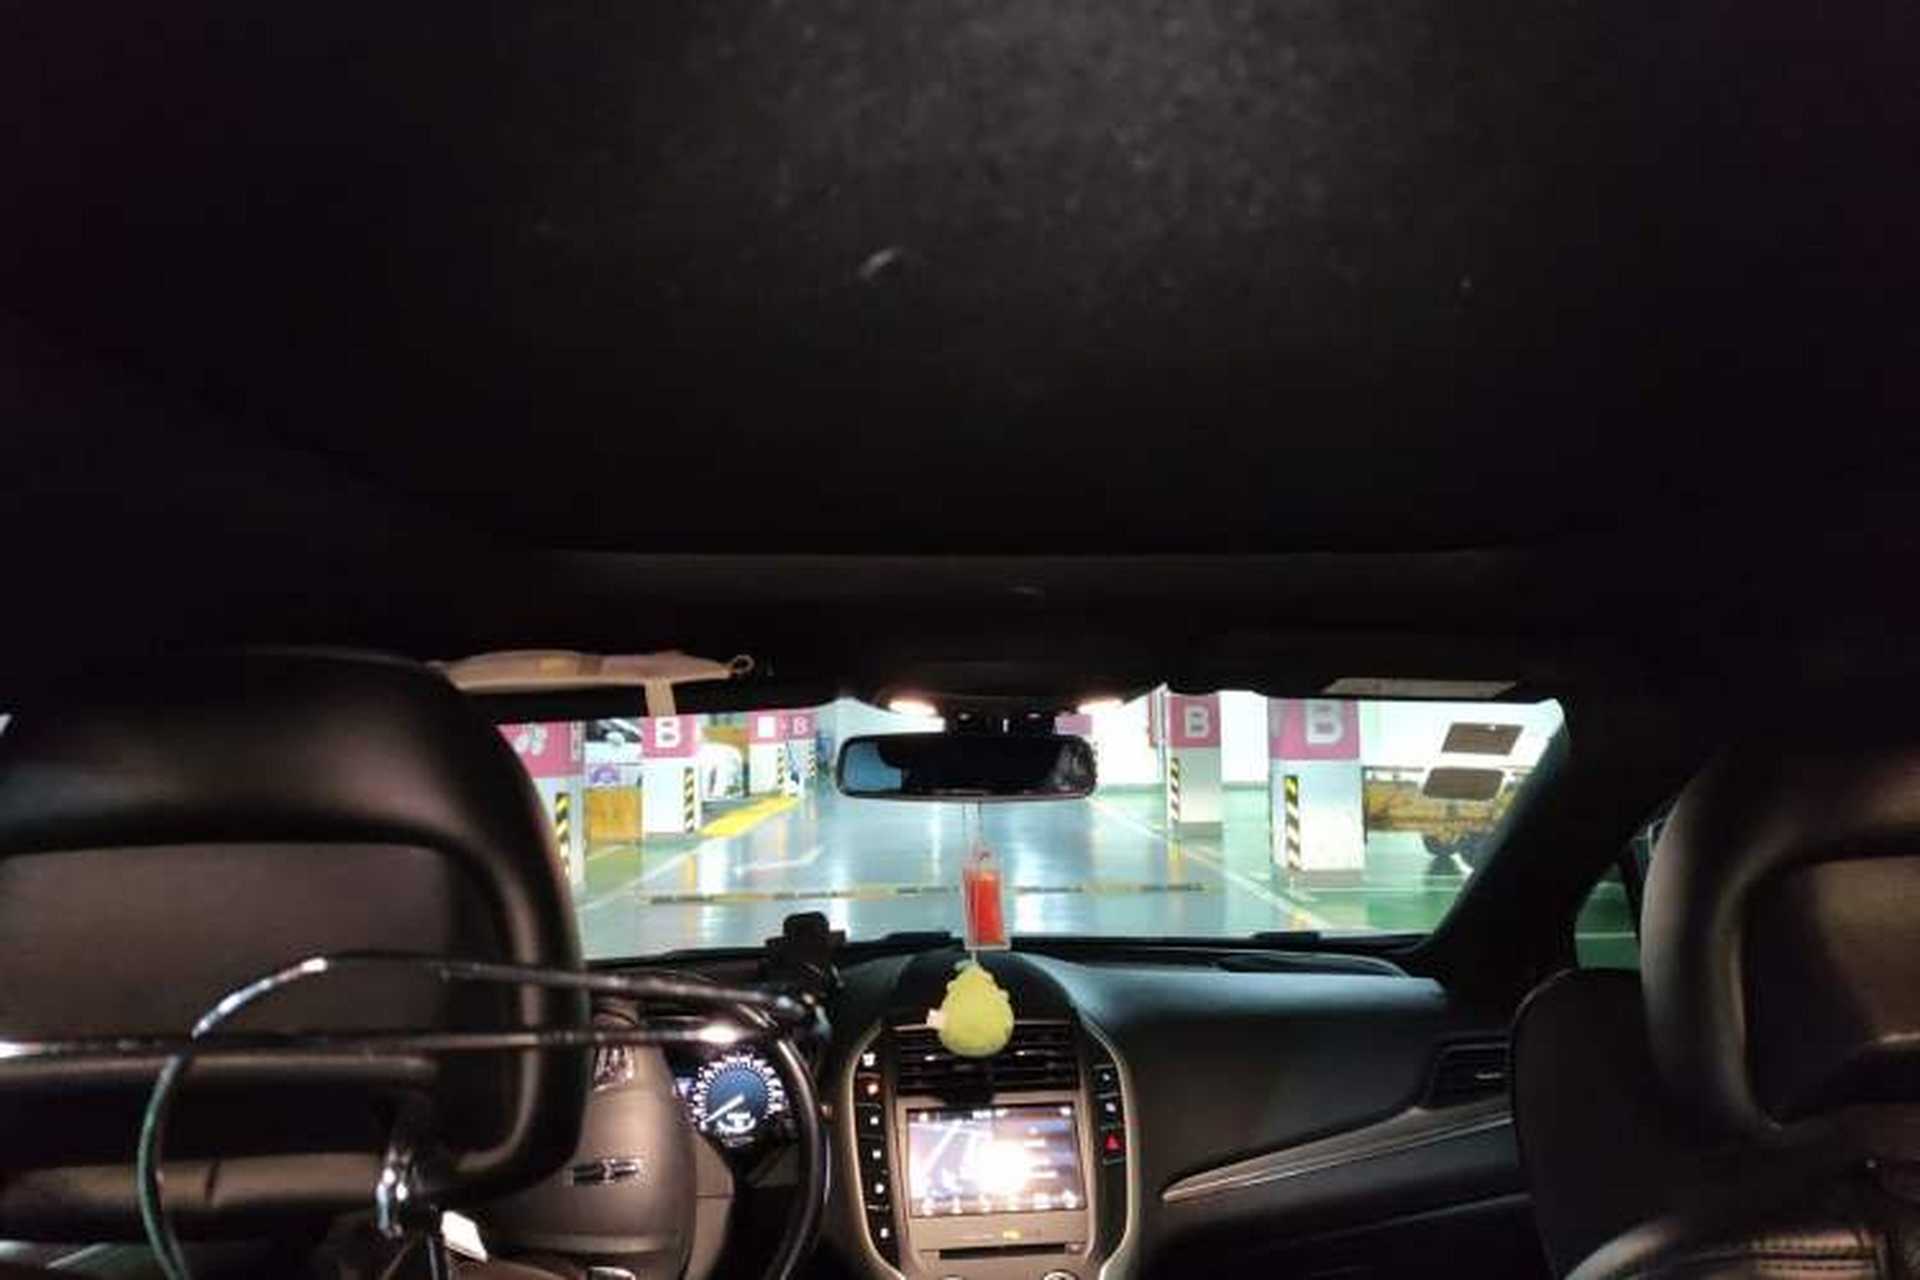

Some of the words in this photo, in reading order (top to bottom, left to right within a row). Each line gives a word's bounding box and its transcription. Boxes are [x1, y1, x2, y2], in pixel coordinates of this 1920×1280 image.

[655, 716, 680, 748] B
[1185, 706, 1209, 738] B
[1305, 699, 1343, 744] B
